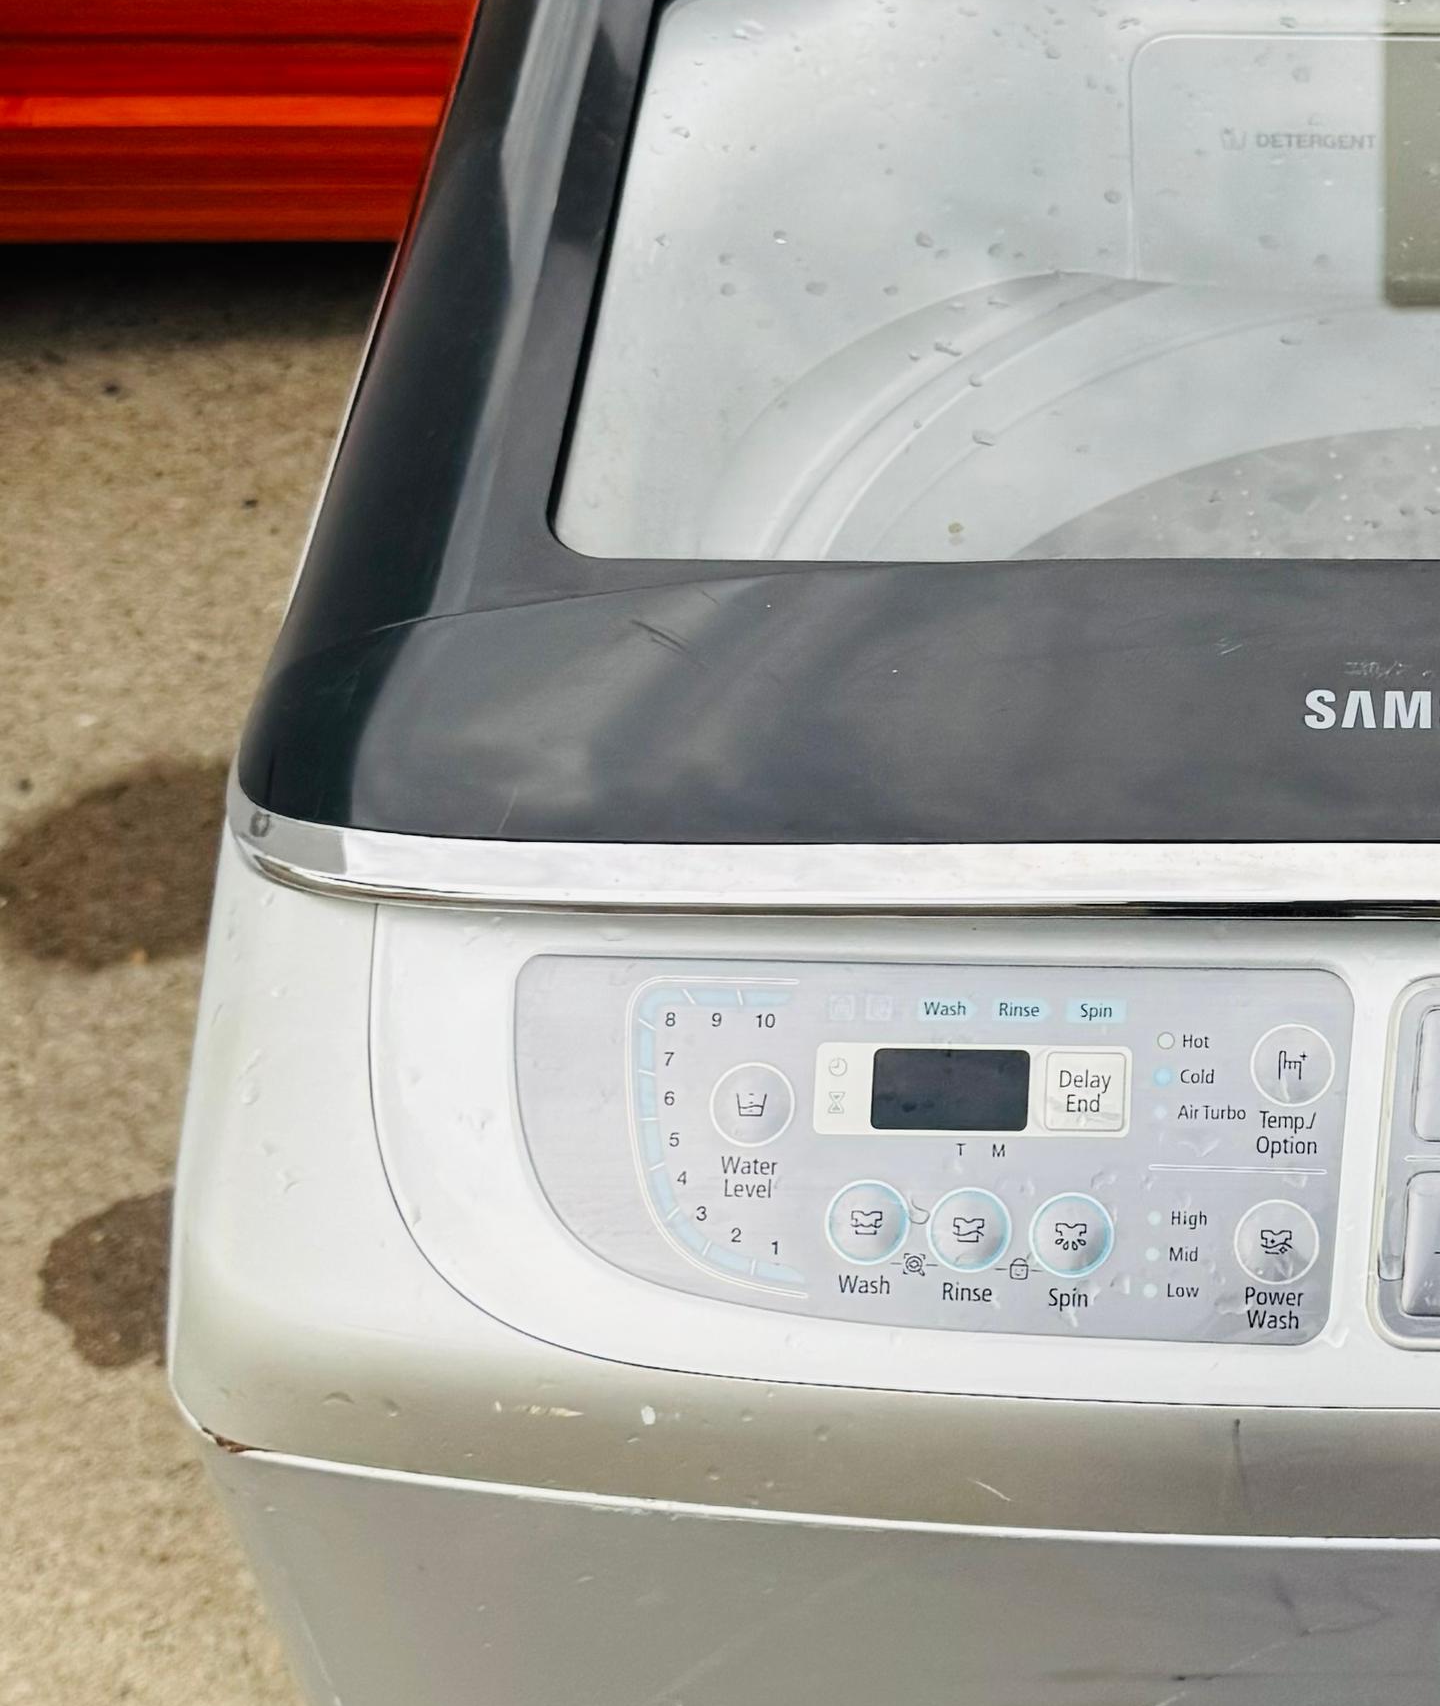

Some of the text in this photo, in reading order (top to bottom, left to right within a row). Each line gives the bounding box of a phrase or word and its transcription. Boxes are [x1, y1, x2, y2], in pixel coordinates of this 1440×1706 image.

[1254, 131, 1376, 151] DETERGENT
[924, 1001, 966, 1016] Wash
[998, 1002, 1040, 1017] Rinse
[1080, 1003, 1113, 1021] Spin
[665, 1011, 776, 1029] 8 9 10
[1182, 1034, 1209, 1049] Hot
[664, 1051, 675, 1067] 7
[1059, 1069, 1112, 1094] Delay
[1180, 1068, 1215, 1084] Cold
[664, 1090, 675, 1106] 6
[1066, 1094, 1101, 1113] End
[1177, 1104, 1247, 1120] Air Turbo
[1258, 1110, 1317, 1134] Temp./
[669, 1132, 680, 1148] 5
[1256, 1136, 1317, 1159] Option
[992, 1143, 1006, 1158] M
[721, 1156, 778, 1176] Water
[677, 1171, 687, 1185] 4
[723, 1178, 772, 1199] Level
[696, 1205, 708, 1222] 3
[1171, 1210, 1208, 1230] High
[730, 1227, 742, 1243] 2
[771, 1241, 779, 1256] 1
[1169, 1246, 1199, 1262] Mid
[838, 1274, 890, 1295] Wash
[942, 1282, 993, 1303] Rinse
[1167, 1283, 1200, 1298] Low
[1048, 1287, 1088, 1312] Spin
[1245, 1286, 1304, 1307] Power
[1246, 1309, 1299, 1330] Wash
